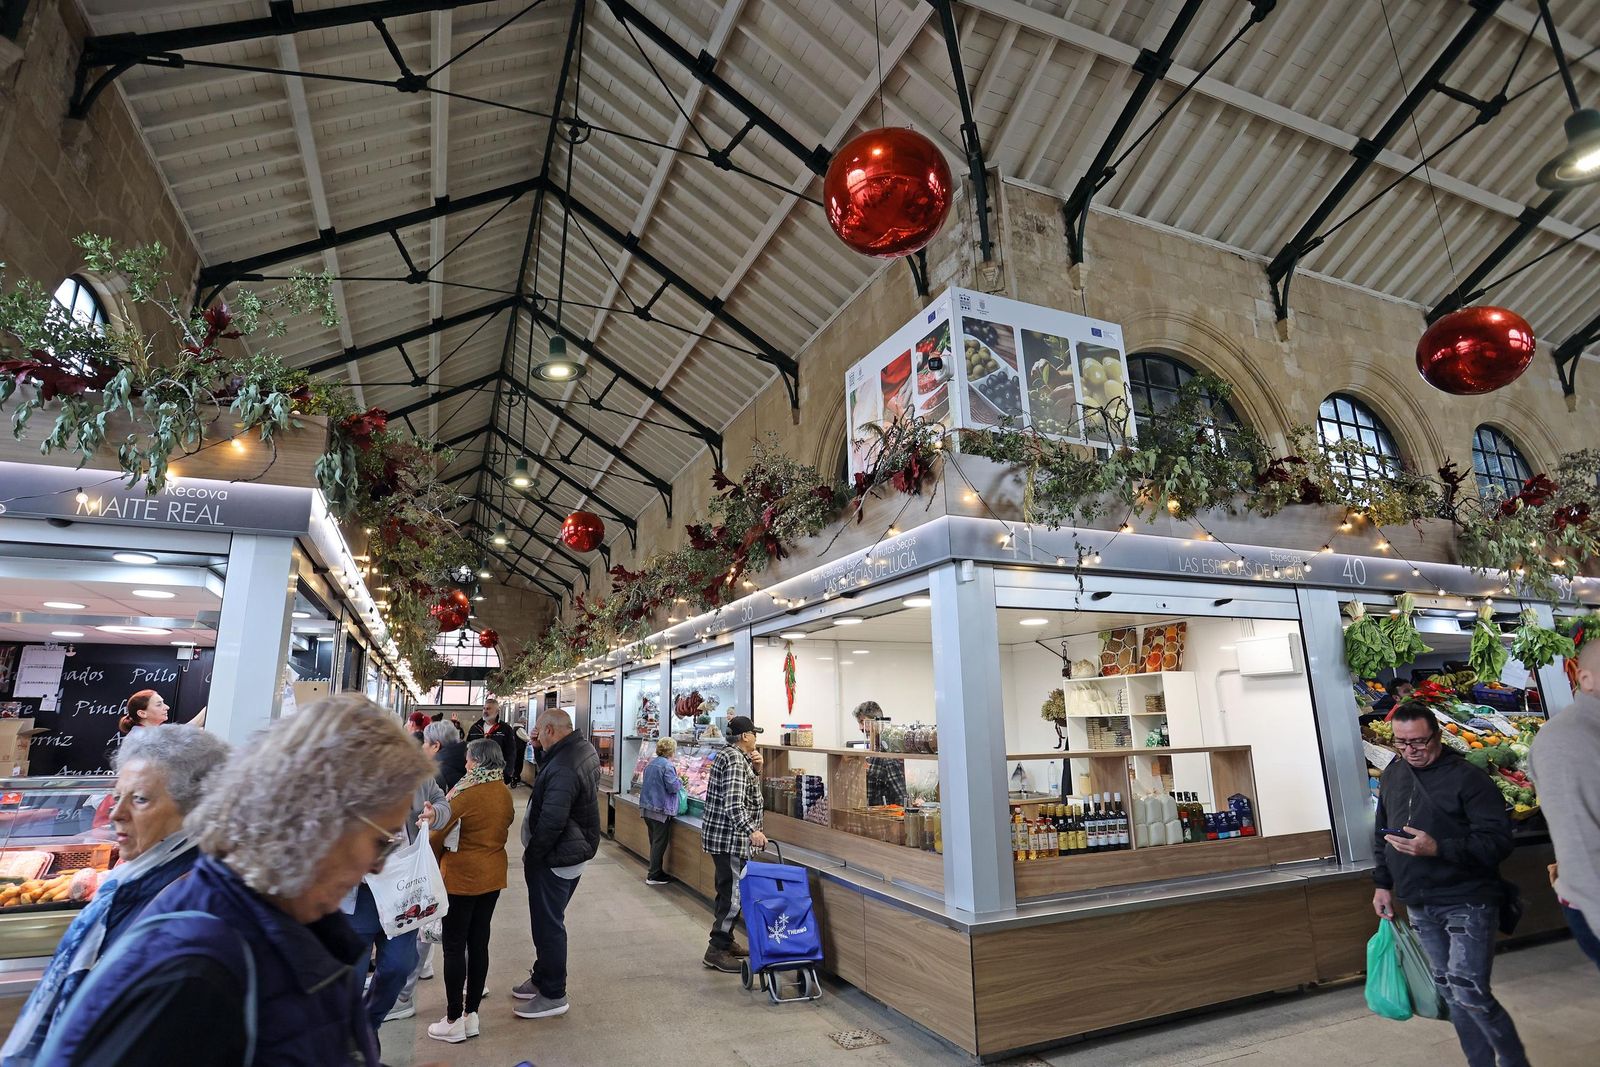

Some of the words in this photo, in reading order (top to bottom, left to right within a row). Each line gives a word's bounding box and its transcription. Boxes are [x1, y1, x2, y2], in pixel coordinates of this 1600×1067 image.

[165, 482, 228, 500] Recova
[76, 496, 159, 520] MAITE
[166, 501, 225, 525] REAL
[1270, 550, 1302, 564] Especias
[838, 565, 873, 590] ESPECIAS
[875, 562, 887, 578] DE
[1178, 556, 1199, 573] LAS
[1202, 558, 1253, 577] ESPECIAS
[1255, 563, 1270, 579] DE
[1342, 557, 1367, 585] 40
[741, 596, 754, 622] 56
[61, 666, 105, 686] nados
[130, 667, 177, 685] Pollo
[73, 699, 129, 717] Pinch
[29, 731, 74, 747] orniz
[396, 876, 427, 891] Carnes
